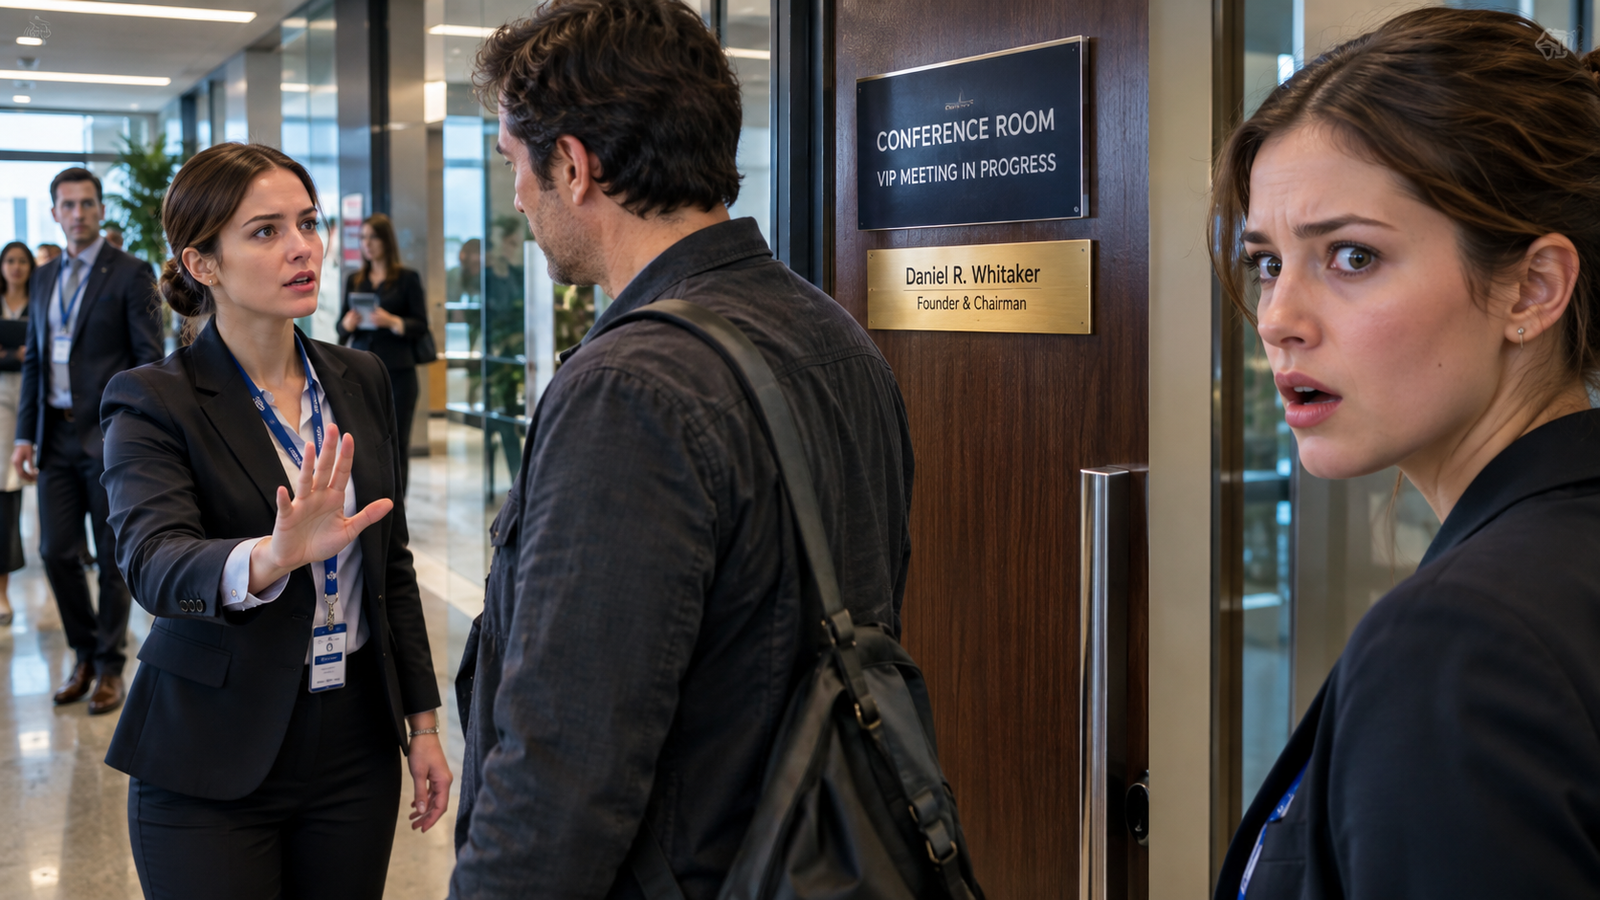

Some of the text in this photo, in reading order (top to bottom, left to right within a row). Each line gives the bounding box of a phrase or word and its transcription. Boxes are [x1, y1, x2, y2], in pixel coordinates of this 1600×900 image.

[877, 108, 1055, 152] CONFERENCE ROOM
[877, 153, 1057, 187] VIP MEETING IN PROGRESS
[906, 263, 1040, 285] Daniel R. Whitaker
[917, 295, 1027, 310] Founder & Chairman
